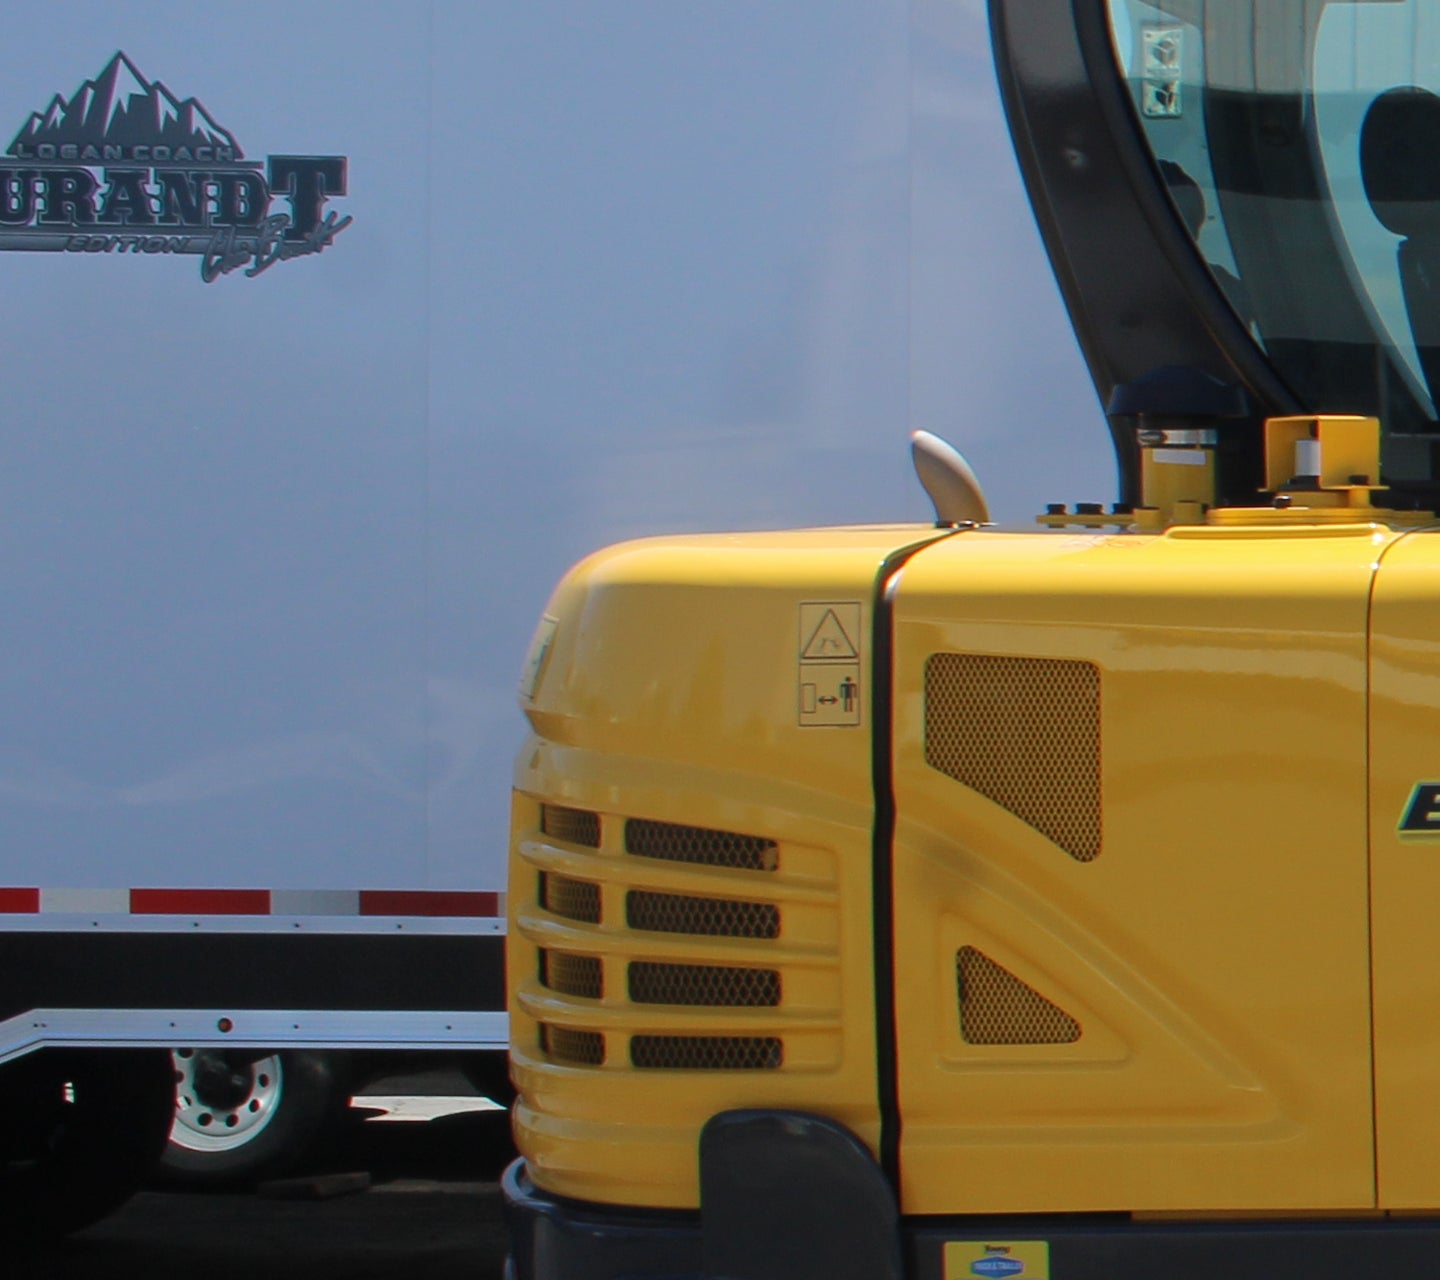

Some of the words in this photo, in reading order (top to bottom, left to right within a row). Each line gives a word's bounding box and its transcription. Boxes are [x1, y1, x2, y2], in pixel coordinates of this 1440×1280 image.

[16, 142, 123, 160] LOGAN
[132, 144, 234, 162] COACH
[67, 235, 191, 254] EDITION
